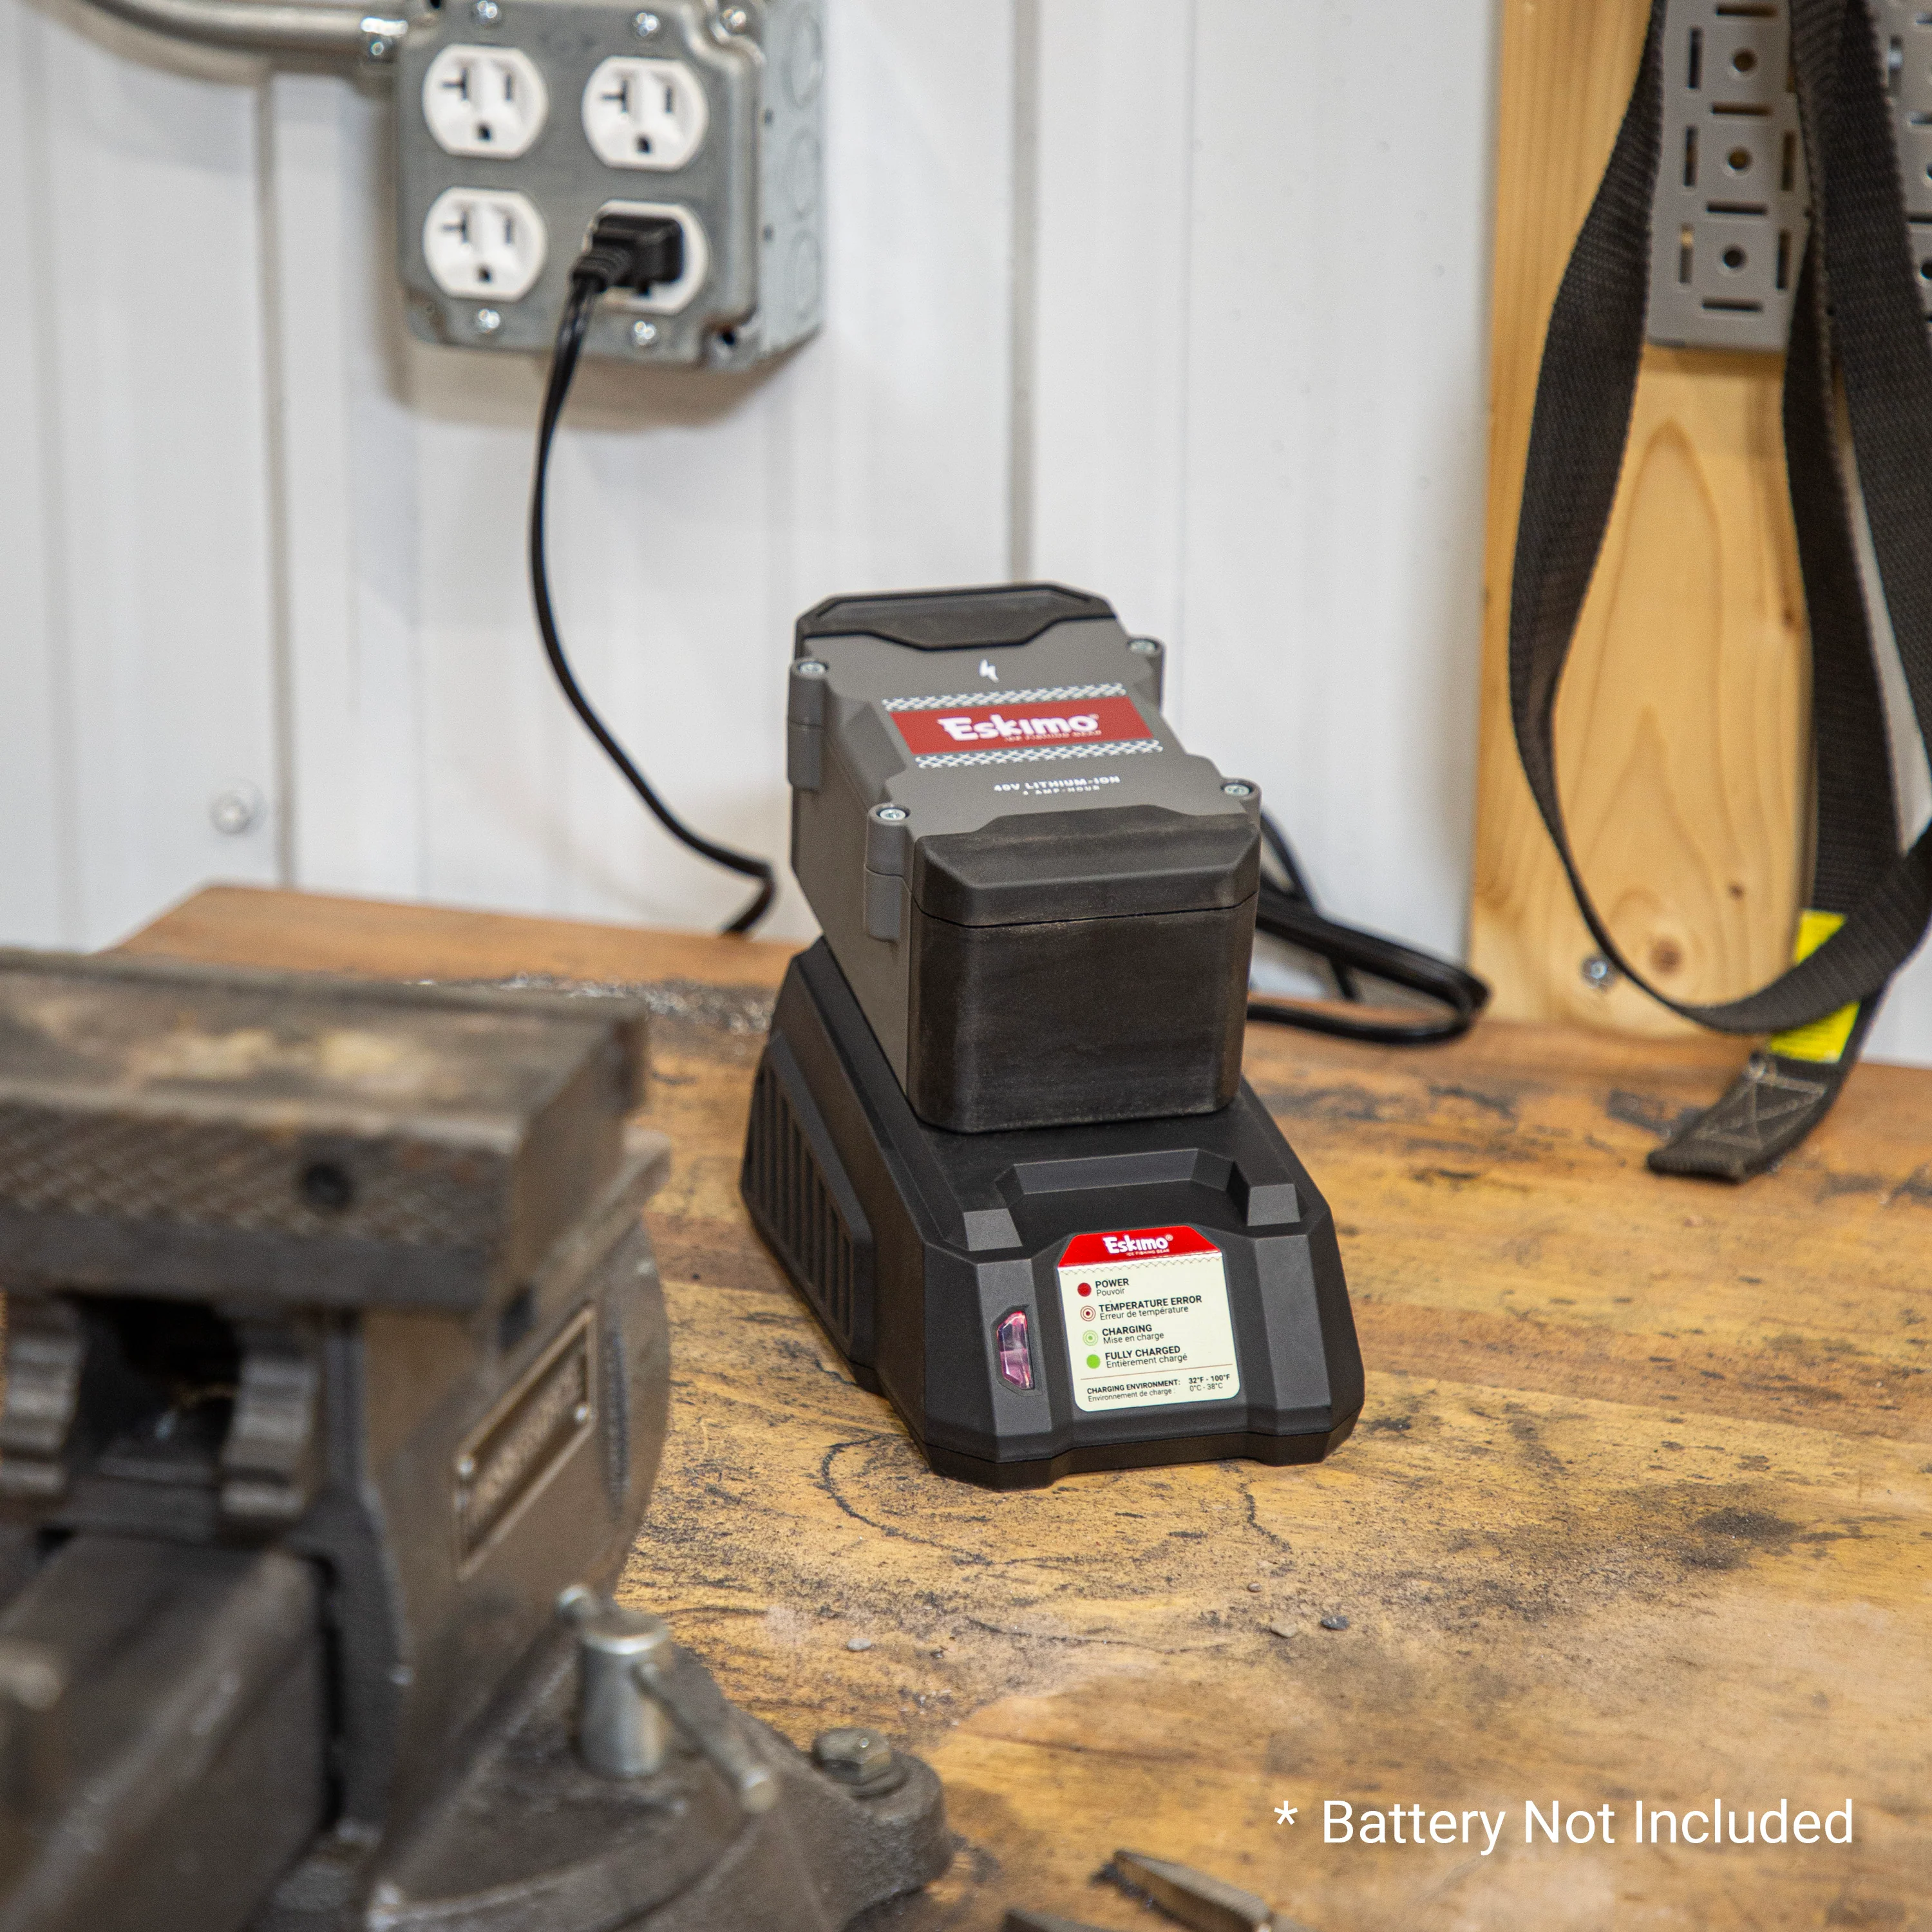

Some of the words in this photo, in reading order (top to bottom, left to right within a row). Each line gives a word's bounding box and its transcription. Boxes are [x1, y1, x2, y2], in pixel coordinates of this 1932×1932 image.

[937, 714, 1098, 741] Eskimo
[994, 783, 1020, 791] 40V
[1025, 775, 1120, 790] LITHIUM-ION
[1102, 1235, 1168, 1254] Eskimo
[1095, 1278, 1129, 1288] POWER
[1096, 1287, 1125, 1296] Pouvoir
[1099, 1298, 1168, 1312] TEMPERATURE
[1171, 1295, 1202, 1305] ERROR
[1100, 1312, 1124, 1320] Erreur
[1139, 1306, 1189, 1316] température
[1102, 1324, 1152, 1336] CHARGING
[1103, 1336, 1123, 1344] Mise
[1137, 1332, 1164, 1341] charge
[1105, 1350, 1132, 1360] FULLY
[1135, 1345, 1180, 1357] CHARGED
[1106, 1357, 1157, 1368] Entièrement
[1159, 1353, 1188, 1363] chargé
[1087, 1385, 1124, 1394] CHARGING
[1126, 1379, 1180, 1390] ENVIRONMENT:
[1088, 1391, 1138, 1403] Environnement
[1149, 1388, 1172, 1397] charge
